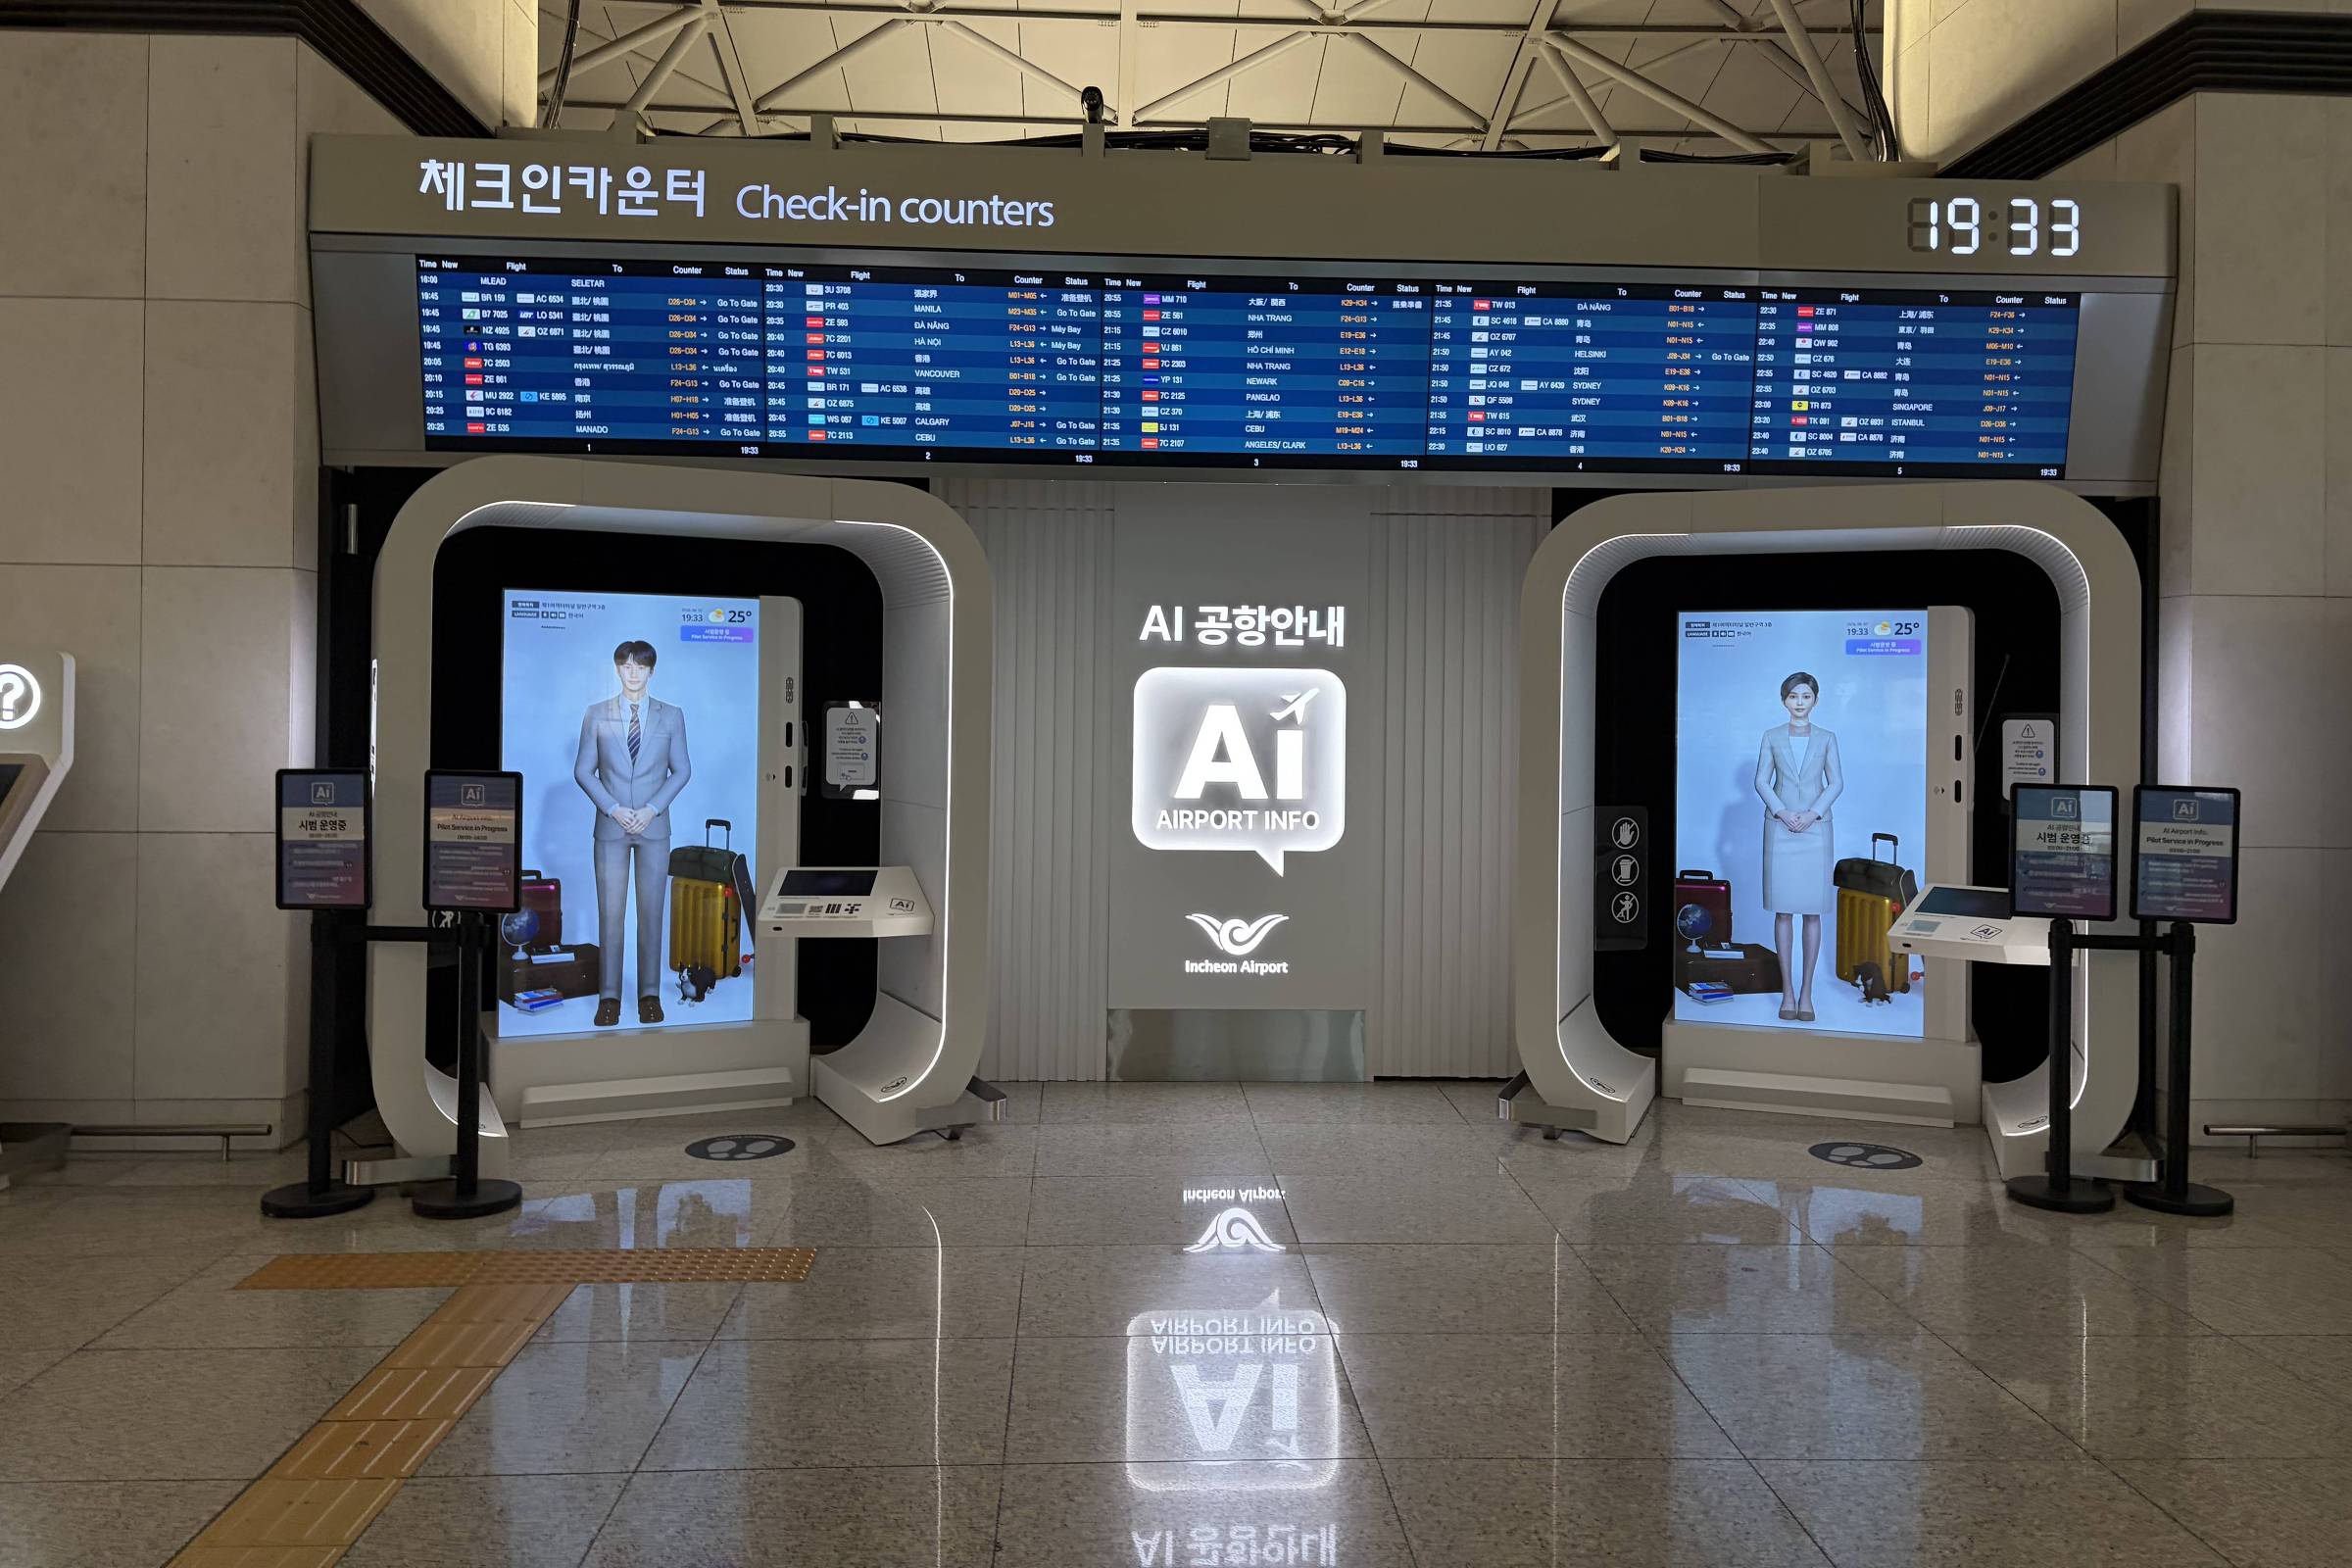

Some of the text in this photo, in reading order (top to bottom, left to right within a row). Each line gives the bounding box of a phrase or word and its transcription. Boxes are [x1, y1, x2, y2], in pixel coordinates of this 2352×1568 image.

[419, 160, 705, 217] 체크인카운터
[737, 184, 1054, 226] Check-in counters
[507, 262, 526, 271] Flight
[725, 267, 749, 275] Status
[851, 271, 870, 280] Flight
[1188, 280, 1205, 289] Flight
[1518, 286, 1536, 295] Flight
[728, 611, 752, 623] 25°
[1139, 605, 1345, 647] AI 공항안내
[1894, 622, 1920, 635] 25°
[1174, 689, 1319, 800] Ai
[299, 819, 347, 831] 시범 운영중
[1156, 809, 1320, 831] AIRPORT INFO
[2036, 832, 2057, 843] 시범
[1185, 960, 1288, 975] Incheon Airport
